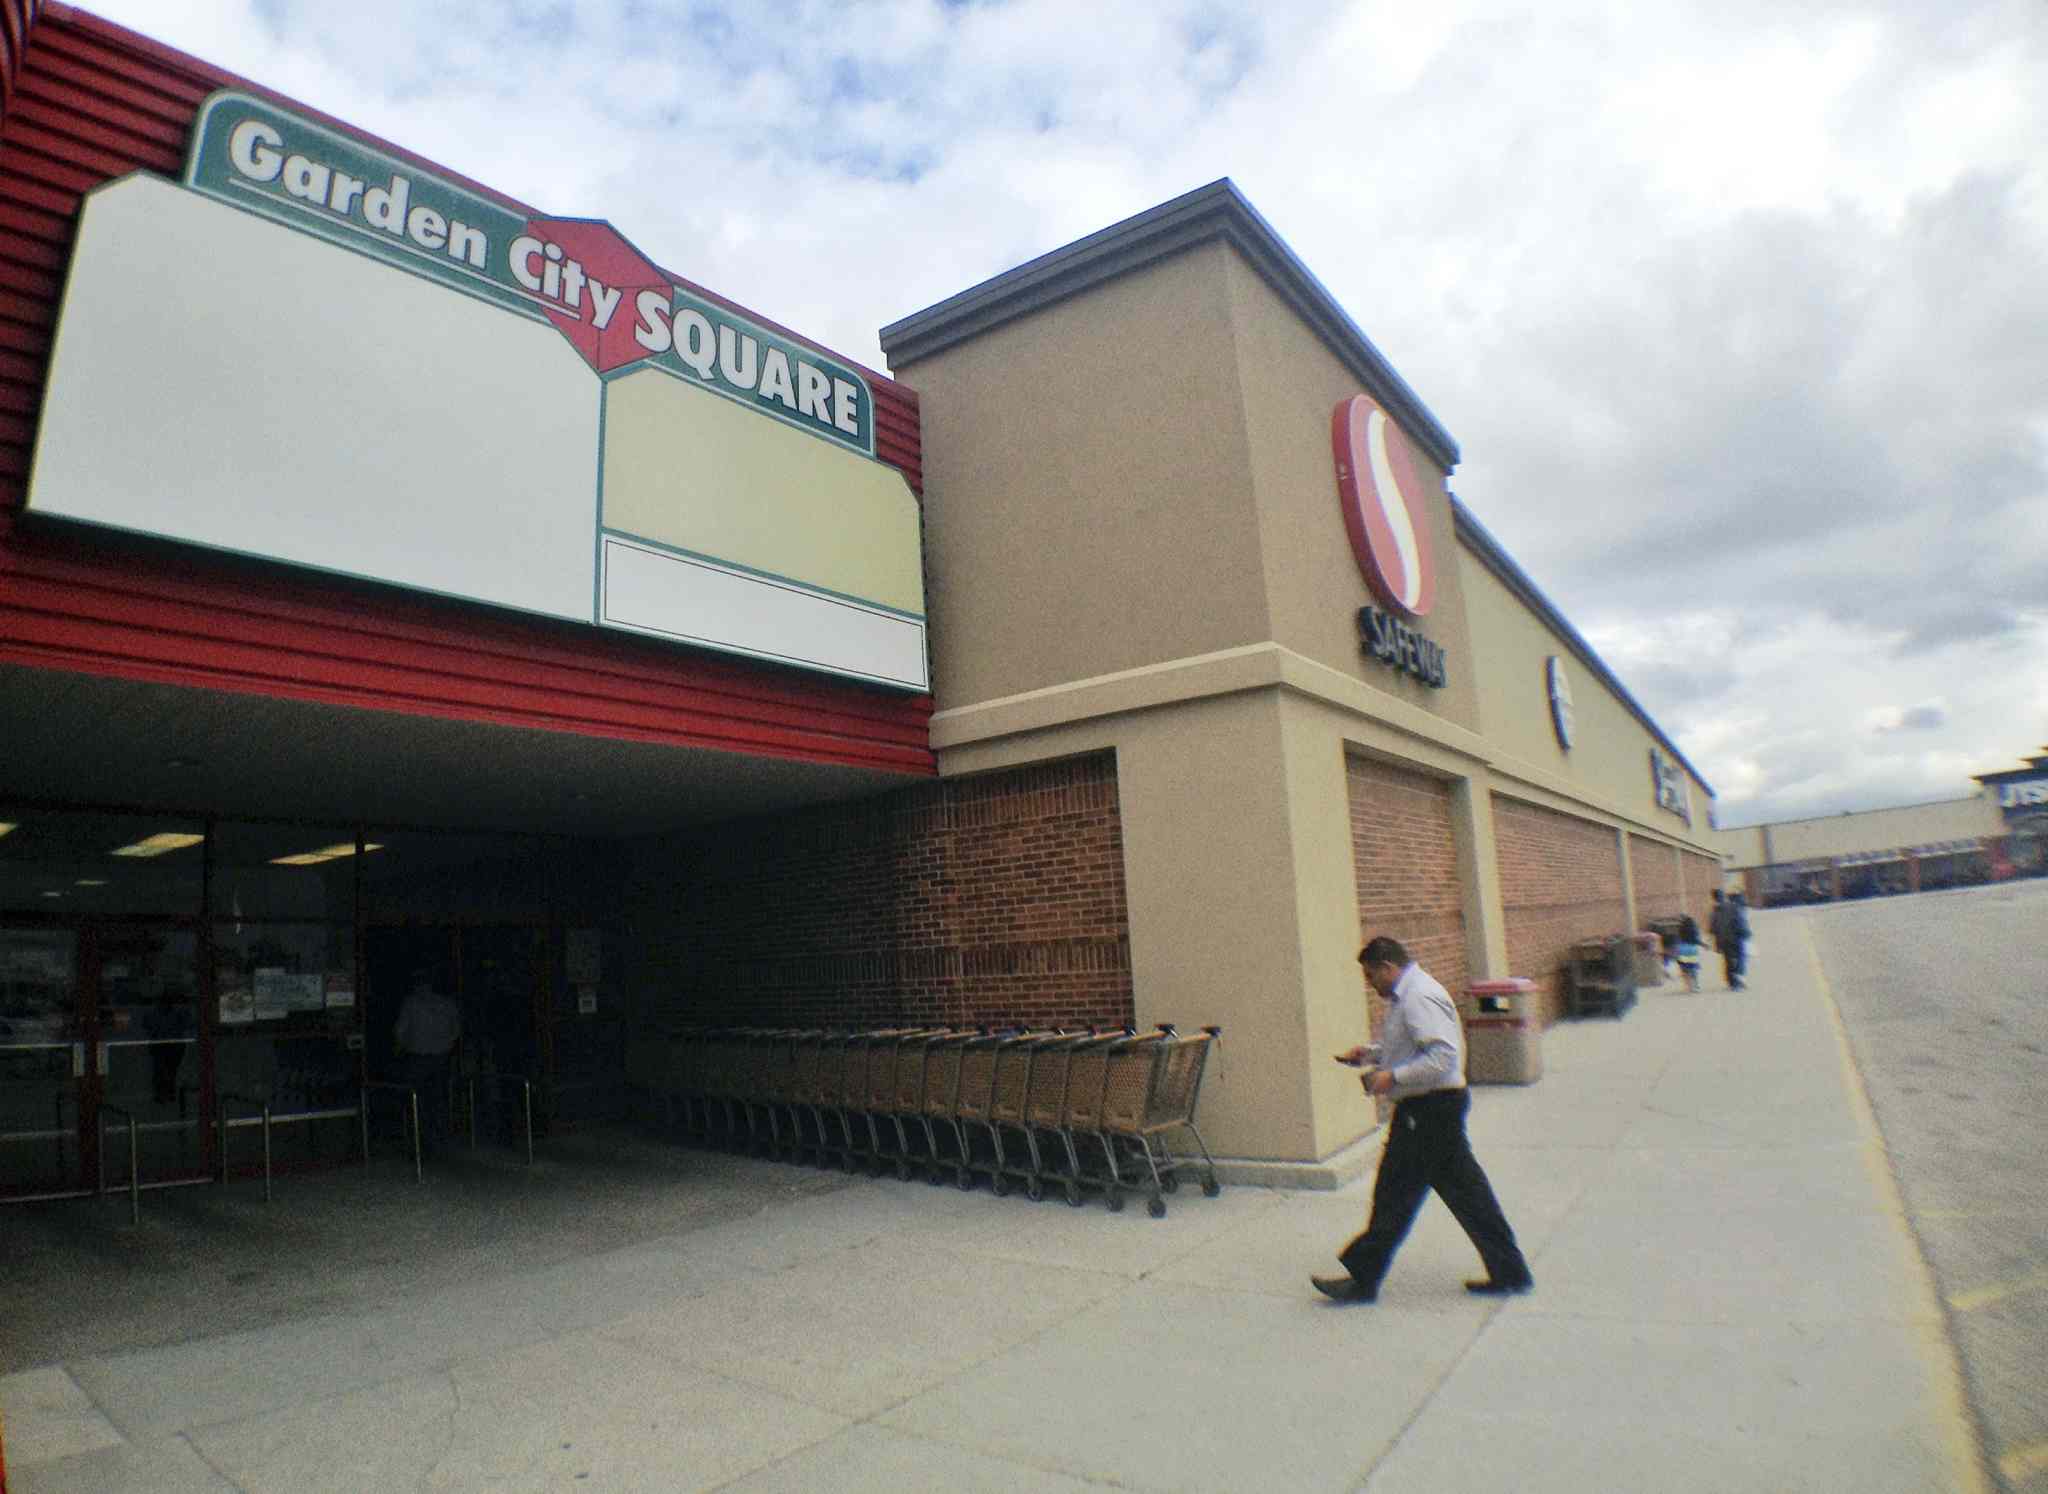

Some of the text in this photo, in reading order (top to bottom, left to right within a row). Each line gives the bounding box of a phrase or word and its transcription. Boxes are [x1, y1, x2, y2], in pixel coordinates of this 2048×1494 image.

[230, 120, 860, 435] Garden City SQUARE
